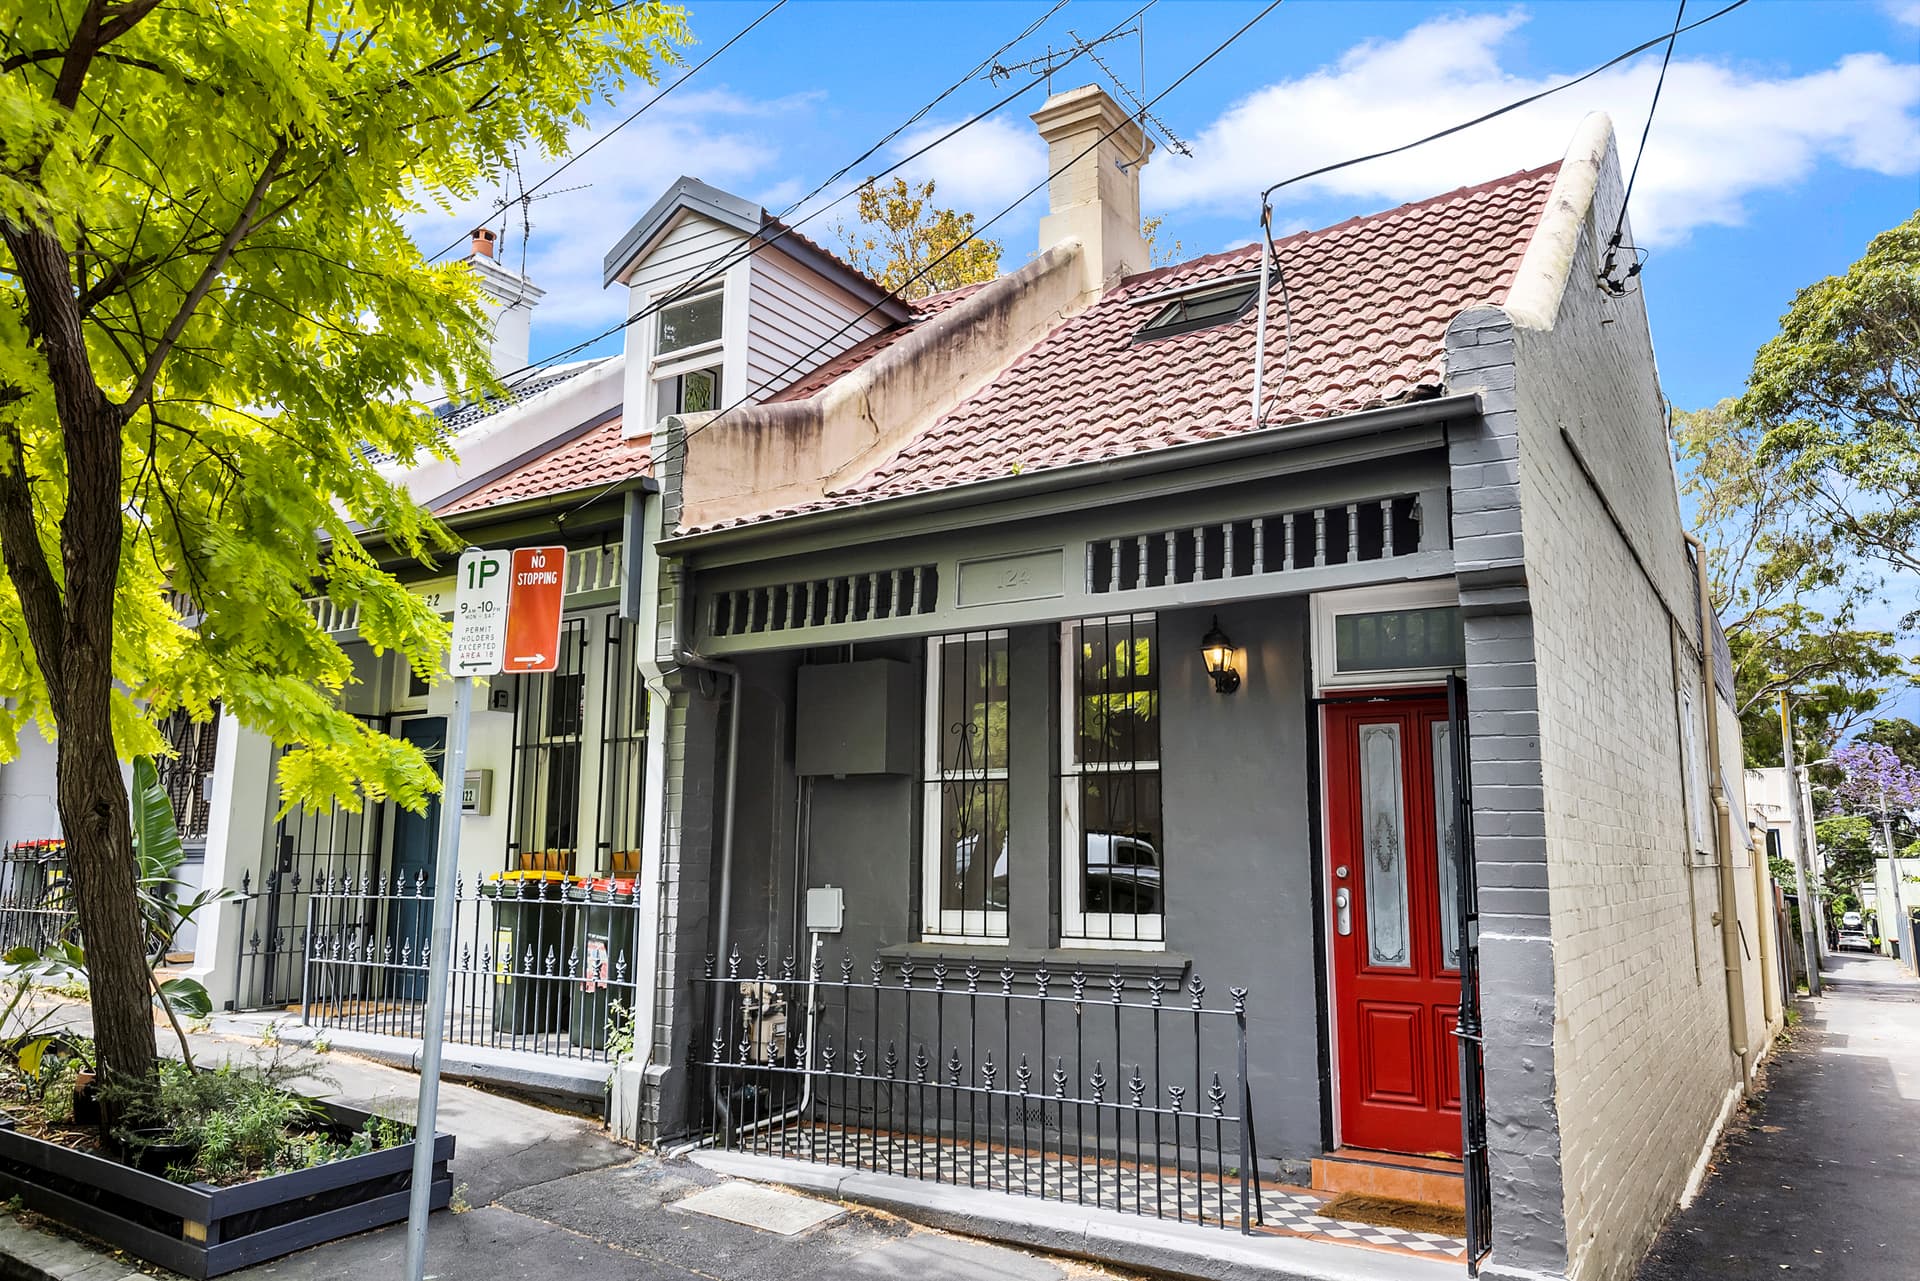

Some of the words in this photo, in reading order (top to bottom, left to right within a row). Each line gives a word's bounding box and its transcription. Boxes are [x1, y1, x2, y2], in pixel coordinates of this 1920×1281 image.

[531, 555, 546, 569] NO
[467, 559, 500, 589] 1P
[517, 571, 558, 586] STOPPING
[465, 625, 492, 634] PERMIT
[461, 634, 495, 642] HOLDERS
[458, 642, 496, 651] EXCEPTED
[460, 651, 481, 659] AREA
